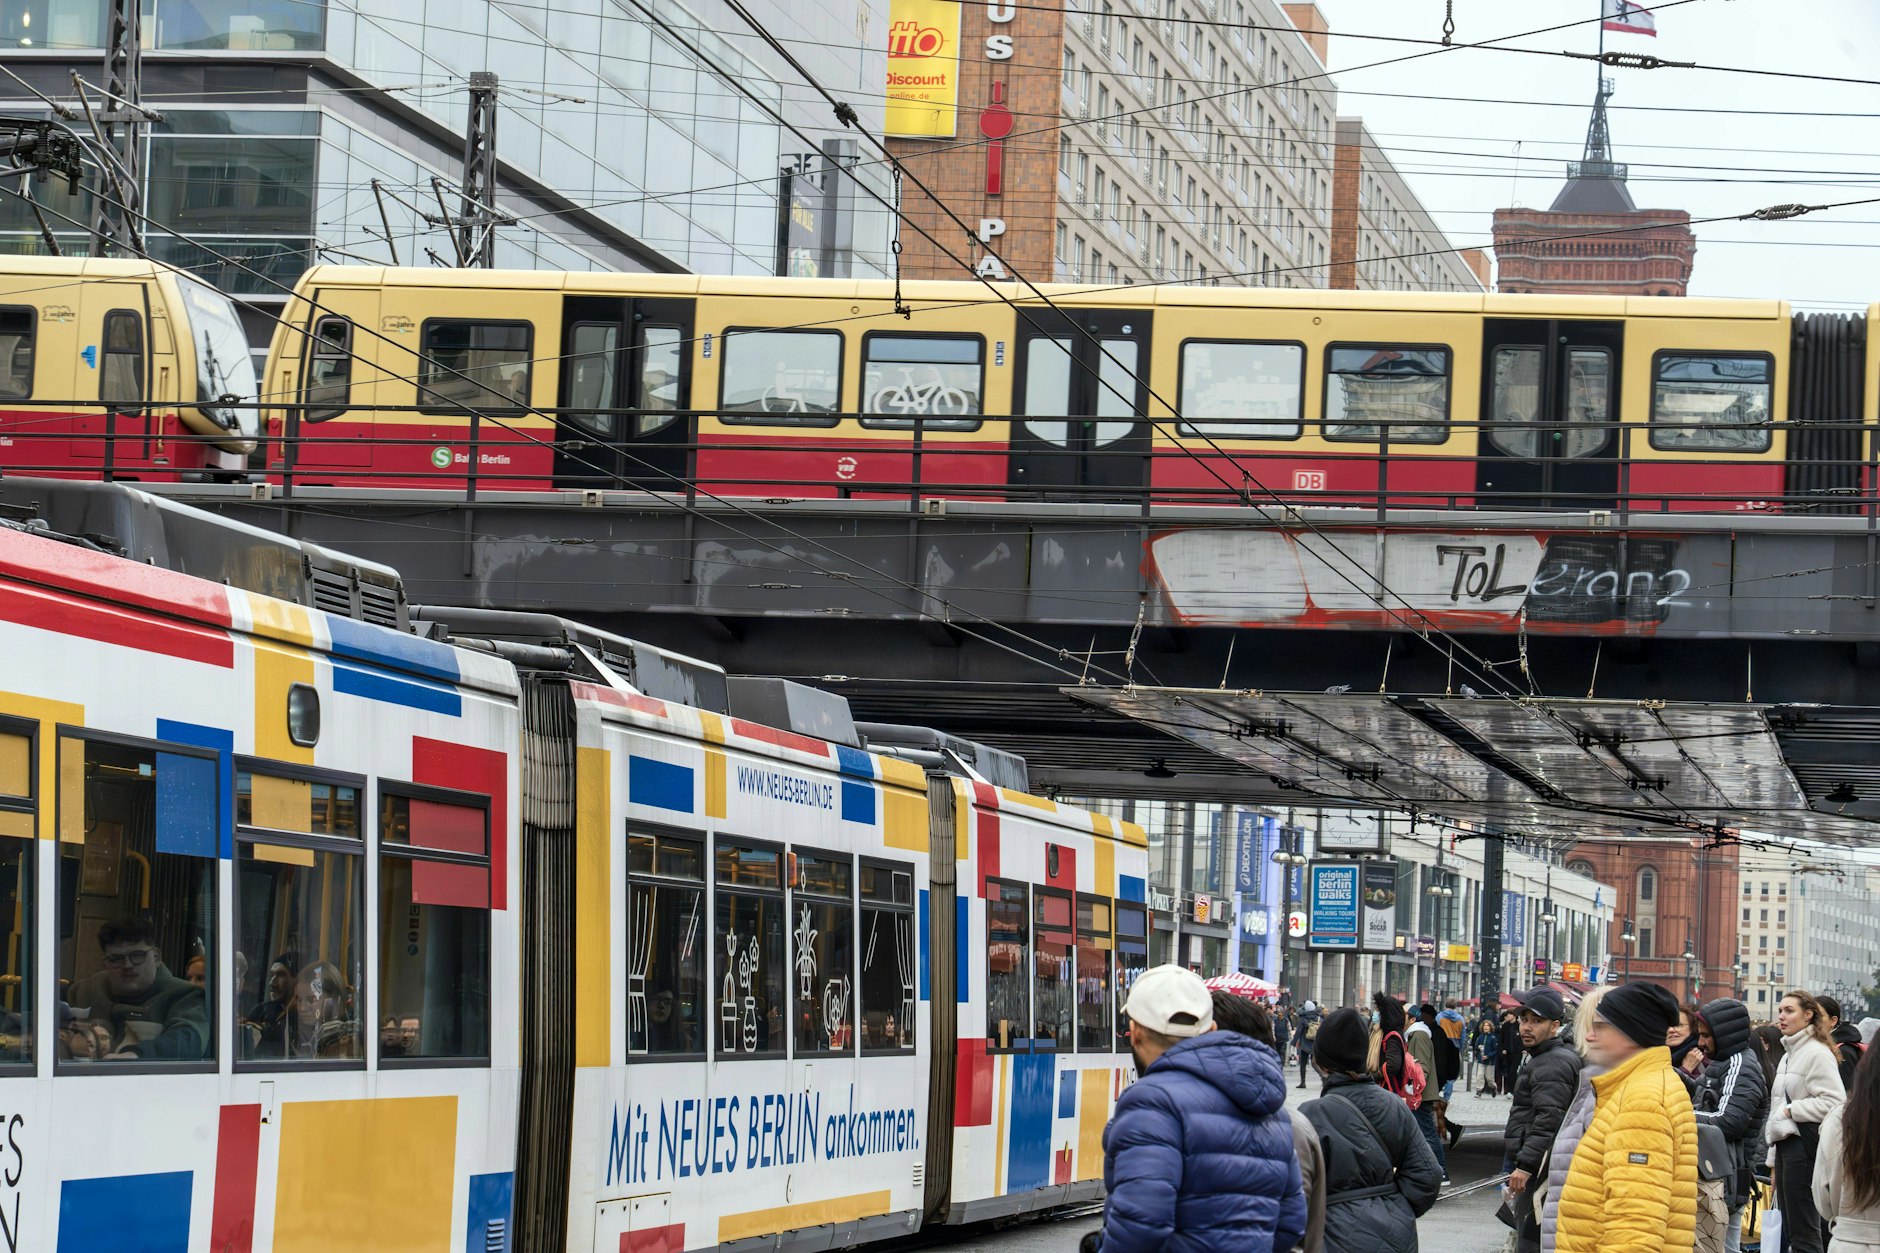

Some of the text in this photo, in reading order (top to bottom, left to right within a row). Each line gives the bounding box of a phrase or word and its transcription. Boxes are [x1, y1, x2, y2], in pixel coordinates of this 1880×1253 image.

[481, 454, 511, 465] Berlin
[1297, 474, 1322, 489] DB
[737, 766, 833, 810] WWW.NEUES-BERLIN.DE
[1241, 818, 1252, 873] DECATHLON
[1318, 870, 1353, 881] original
[1318, 880, 1352, 889] berlin
[1318, 889, 1352, 900] walks
[1514, 897, 1523, 934] DECATHLON
[606, 1082, 919, 1188] Mit NEUES BERLIN ankommen.
